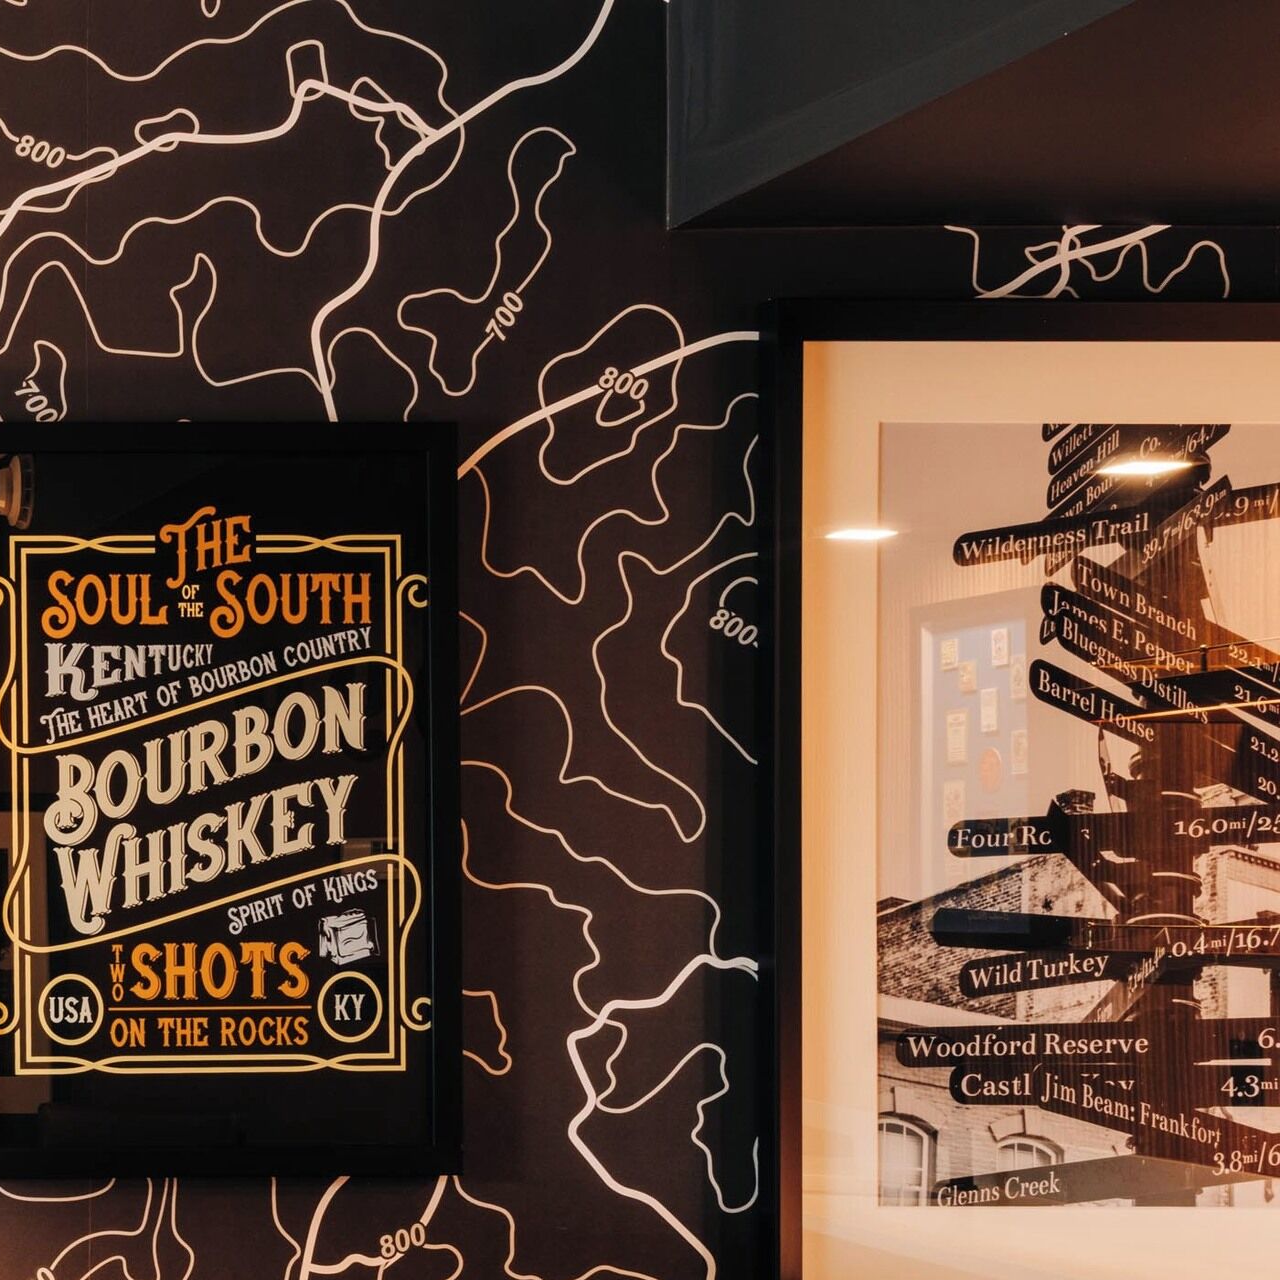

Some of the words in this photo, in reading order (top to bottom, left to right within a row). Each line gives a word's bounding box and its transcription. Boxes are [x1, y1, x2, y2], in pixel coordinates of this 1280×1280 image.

[15, 134, 66, 169] 800
[486, 290, 525, 341] 700
[14, 379, 58, 422] 700
[597, 367, 649, 401] 800
[1050, 453, 1097, 503] Heaven
[1096, 428, 1120, 464] Hill
[159, 506, 252, 589] THE
[959, 524, 1087, 561] Wilderness
[1092, 512, 1151, 541] Trail
[41, 570, 169, 639] SOUL
[209, 570, 372, 639] SOUTH
[178, 602, 203, 618] THE
[181, 584, 200, 600] OF
[1077, 563, 1131, 609] Town
[1135, 593, 1197, 641] Branch
[709, 605, 757, 647] 800
[1049, 589, 1108, 634] James
[1112, 622, 1130, 646] E.
[1135, 622, 1195, 674] Pepper
[40, 707, 83, 744] THE
[88, 690, 148, 728] HEART
[156, 680, 182, 707] OF
[191, 650, 278, 698] BOURBON
[283, 626, 372, 667] COUNTRY
[44, 642, 214, 701] KENTUCKY
[1062, 616, 1138, 682] Bluegrass
[1140, 665, 1210, 725] Distillers
[1038, 668, 1096, 715] Barrel
[1100, 699, 1155, 742] House
[43, 682, 367, 847] BOURBON
[53, 774, 359, 935] WHISKEY
[956, 828, 1014, 849] Four
[227, 892, 285, 935] SPIRIT
[292, 884, 317, 909] OF
[322, 869, 378, 903] KINGS
[110, 944, 126, 1003] TWO
[130, 941, 311, 1000] SHOTS
[969, 965, 1022, 990] Wild
[1027, 954, 1110, 981] Turkey
[48, 996, 93, 1024] USA
[109, 1017, 146, 1048] ON
[157, 1017, 209, 1047] THE
[220, 1016, 309, 1046] ROCKS
[334, 994, 366, 1021] KY
[907, 1028, 1037, 1059] Woodford
[1043, 1033, 1150, 1056] Reserve
[1040, 1072, 1077, 1104] Jim
[1082, 1083, 1136, 1122] Beam:
[1140, 1102, 1222, 1147] Frankfort
[937, 1185, 1000, 1207] Glenns
[1004, 1172, 1061, 1199] Creek
[378, 1223, 426, 1260] 800
